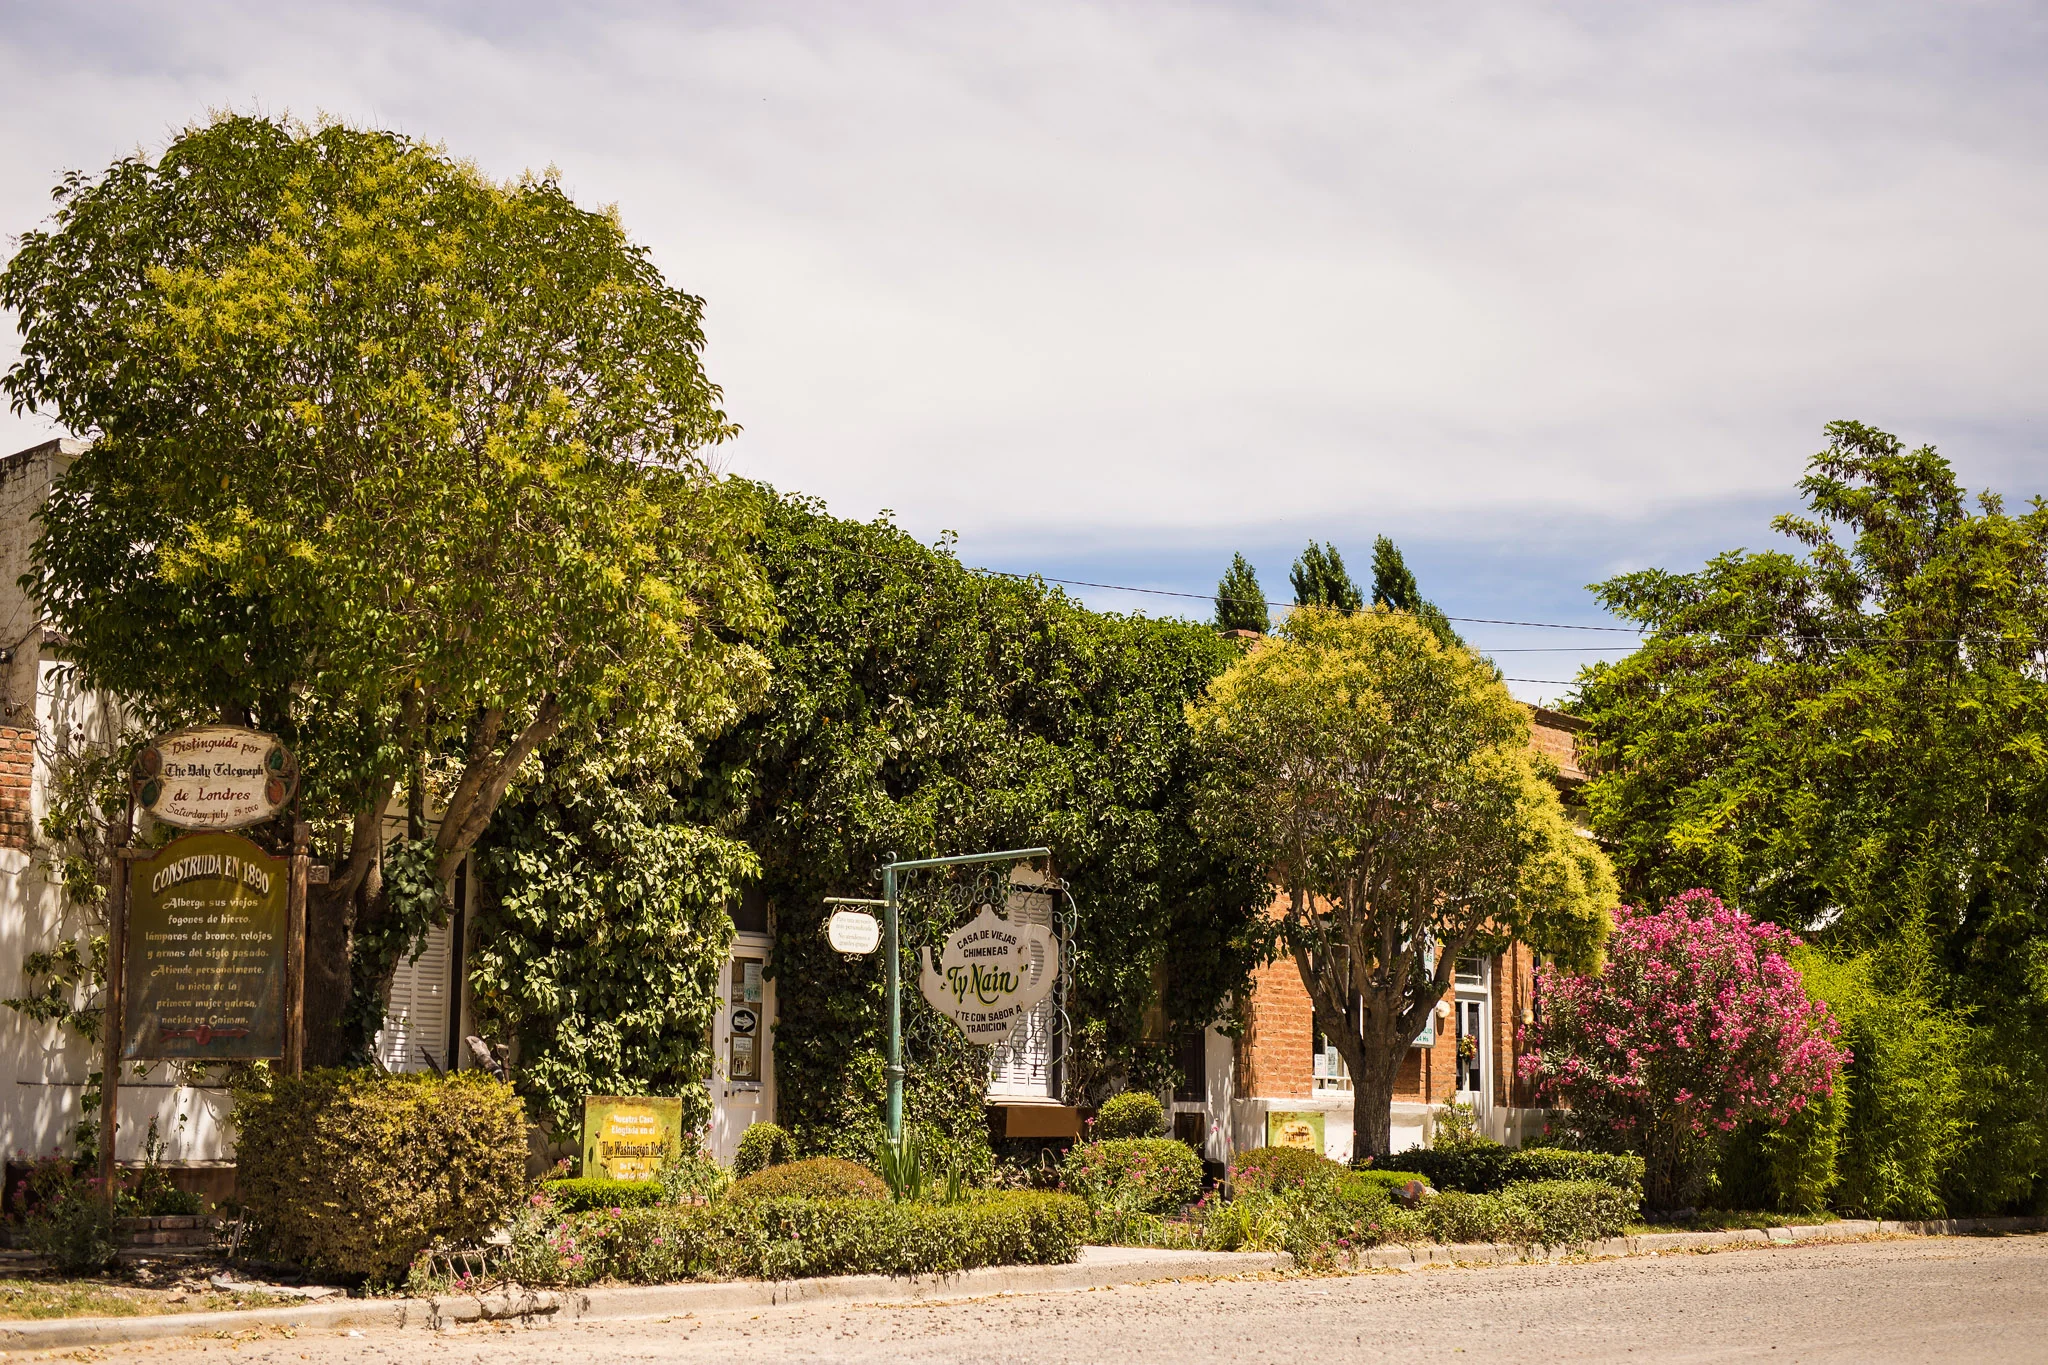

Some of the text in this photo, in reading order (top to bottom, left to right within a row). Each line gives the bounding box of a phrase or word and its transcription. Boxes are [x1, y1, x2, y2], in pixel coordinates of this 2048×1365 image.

[172, 737, 261, 756] Distinguida por
[165, 762, 187, 778] The
[213, 762, 263, 778] Telegraph
[174, 788, 251, 802] de Londres
[211, 810, 229, 823] july
[152, 854, 270, 894] CONSTRUIDA EN 1890
[162, 898, 258, 909] Alberga sus viejos
[168, 914, 204, 926] fogones
[207, 914, 218, 924] de
[145, 931, 188, 944] lámparas
[191, 932, 203, 941] de
[240, 931, 273, 943] relojes
[956, 929, 1018, 950] CASA DE VIEJAS
[147, 951, 153, 960] y
[156, 949, 186, 957] armas
[188, 948, 203, 957] del
[206, 948, 229, 960] siglo
[963, 945, 1009, 958] CHIMENEAS
[150, 964, 192, 977] Atiende
[176, 982, 237, 991] la nieta de la
[156, 998, 192, 1010] primera
[195, 998, 222, 1010] mujer
[161, 1014, 192, 1025] nacida
[954, 1004, 1022, 1022] Y TE CON SABOR A
[966, 1021, 1007, 1034] TRADICION
[612, 1126, 638, 1136] Elogiada
[602, 1141, 614, 1156] The
[614, 1141, 649, 1157] Washington
